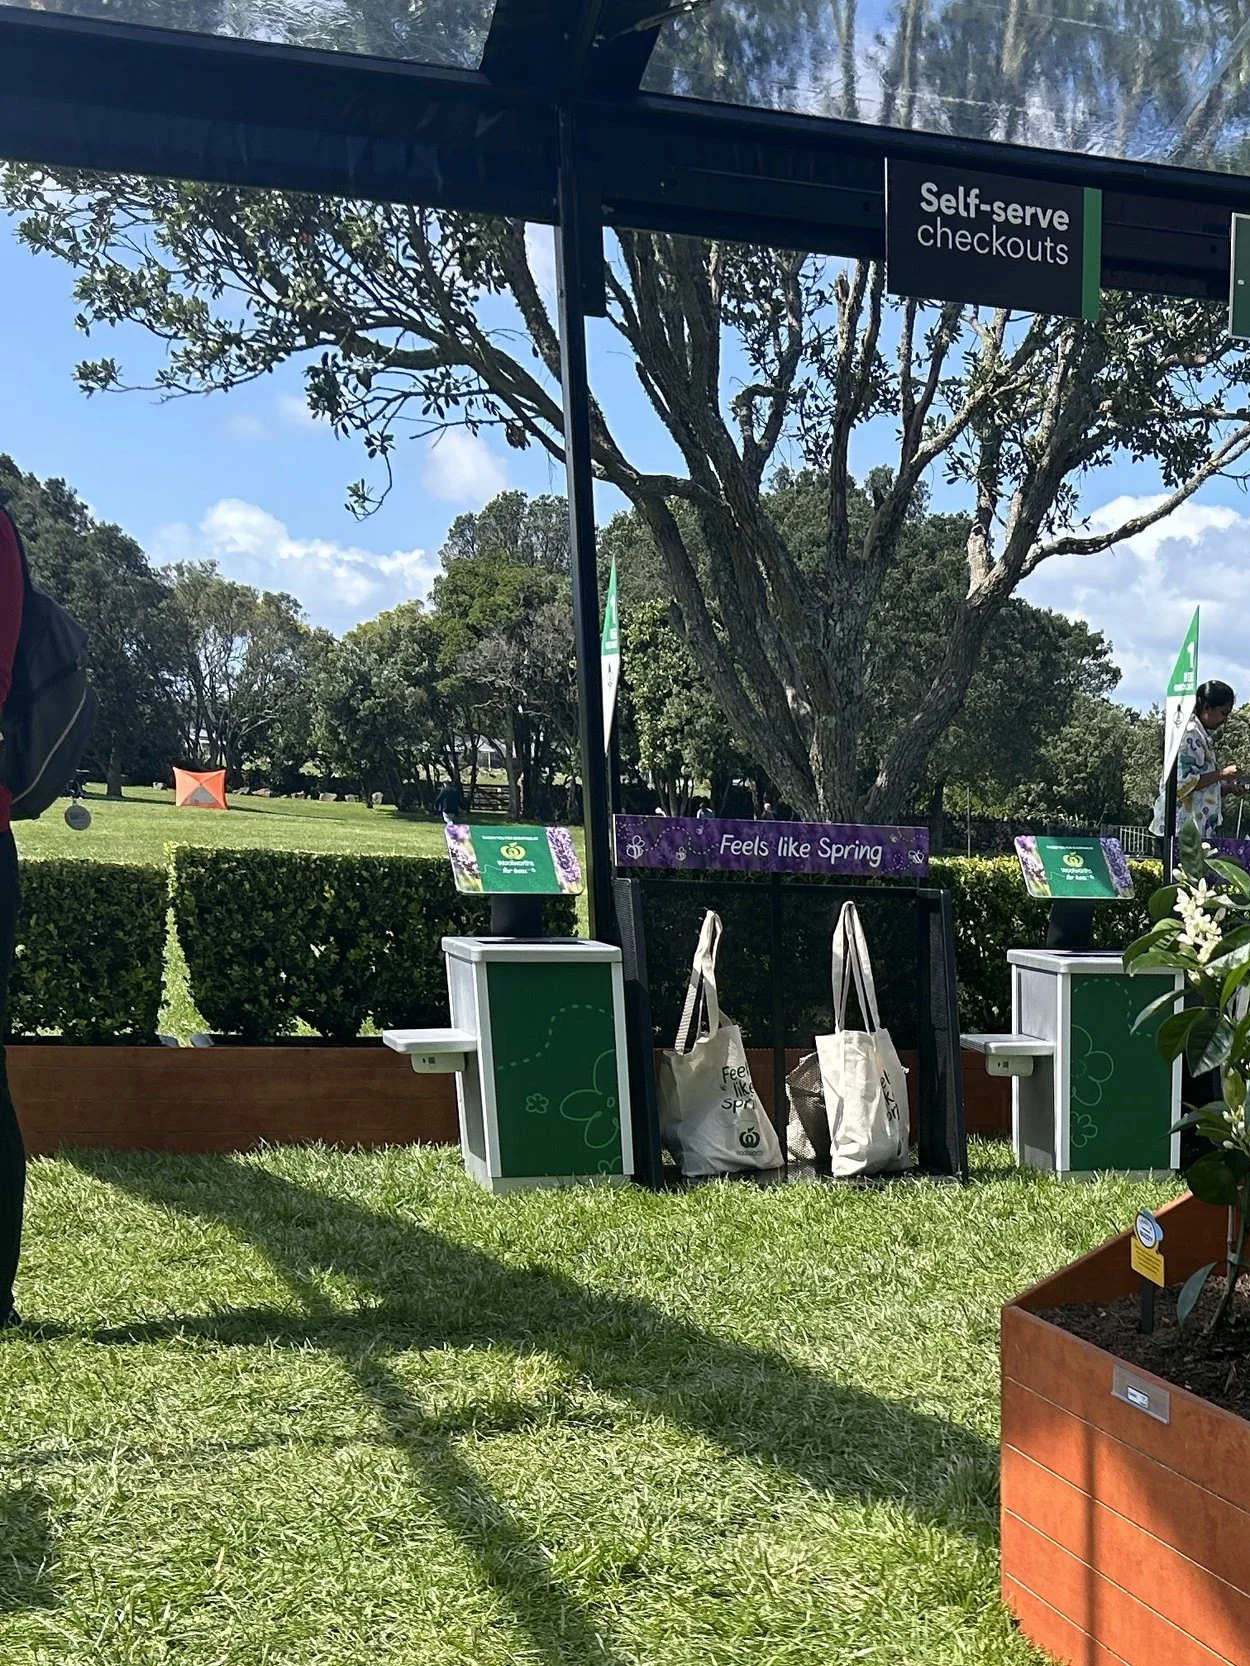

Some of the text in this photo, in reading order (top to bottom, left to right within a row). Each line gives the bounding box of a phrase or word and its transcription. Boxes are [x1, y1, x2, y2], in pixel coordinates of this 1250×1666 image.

[919, 181, 1070, 232] Self-serve
[916, 217, 1070, 266] checkouts
[719, 833, 883, 868] Feels like Spring
[722, 1061, 750, 1084] Feel
[733, 1080, 755, 1098] like
